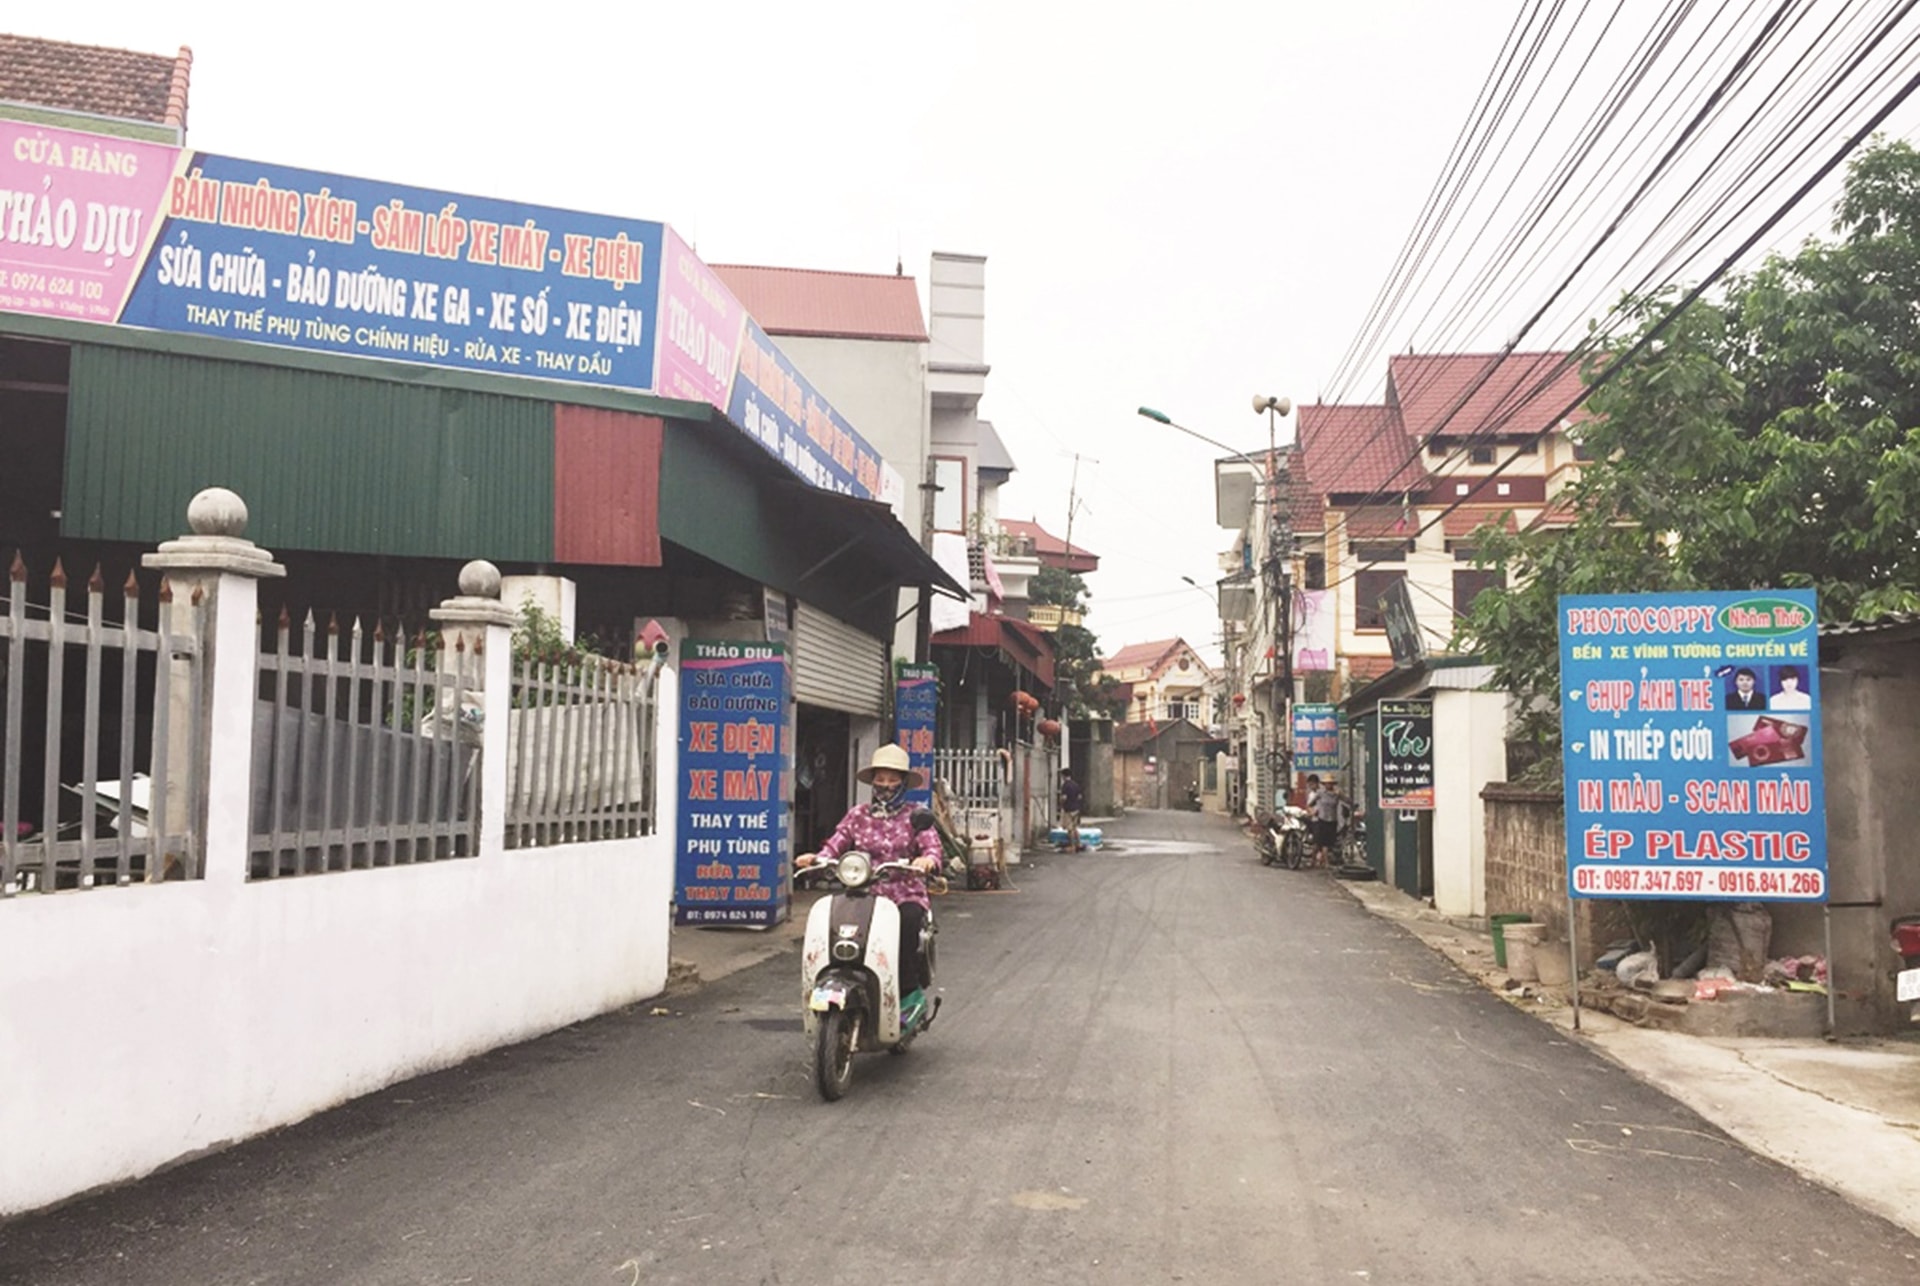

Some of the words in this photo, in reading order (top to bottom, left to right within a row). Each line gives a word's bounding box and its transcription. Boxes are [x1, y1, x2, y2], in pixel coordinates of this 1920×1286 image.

[14, 131, 65, 167] CỬA
[69, 143, 138, 177] HÀNG
[0, 175, 78, 249] THẢO
[82, 202, 142, 268] DỊU
[168, 167, 221, 224] BÁN
[220, 178, 301, 236] NHÔNG
[301, 188, 357, 244] XÍCH
[371, 199, 424, 254] SĂM
[424, 202, 468, 260] LỐP
[467, 219, 499, 266] XE
[500, 219, 549, 272] MÁY
[562, 233, 592, 278] XE
[592, 231, 643, 291] ĐIỆN
[11, 271, 46, 293] 0974
[48, 276, 75, 296] 624
[80, 280, 104, 300] 100
[157, 230, 202, 289] SỬA
[208, 246, 266, 298] CHỮA
[286, 249, 330, 307] BẢO
[334, 265, 407, 317] DƯỠNG
[410, 281, 439, 321] XE
[443, 285, 470, 326] GA
[489, 291, 516, 331] XE
[521, 286, 551, 336] SỐ
[565, 302, 592, 341] XE
[596, 300, 642, 353] ĐIỆN
[186, 304, 231, 328] THAY
[234, 307, 265, 332] THẾ
[267, 316, 301, 340] PHỤ
[305, 316, 350, 343] TÙNG
[355, 325, 409, 351] CHÍNH
[413, 333, 449, 359] HIỆU
[465, 337, 497, 362] RỬA
[500, 346, 521, 364] XE
[535, 351, 575, 372] THAY
[1568, 605, 1717, 635] PHOTOCOPPY
[1728, 607, 1771, 629] Nhâm
[1773, 606, 1806, 629] Thức
[696, 642, 739, 658] THẢO
[1572, 642, 1602, 660] BẾN
[1610, 645, 1630, 659] XE
[1633, 643, 1668, 659] VĨNH
[696, 667, 728, 688] SỬA
[730, 671, 773, 688] CHỮA
[1586, 679, 1634, 718] CHỤP
[1638, 667, 1676, 711] ẢNH
[1680, 667, 1714, 711] THẺ
[688, 690, 720, 712] BẢO
[724, 694, 778, 713] DƯỠNG
[688, 721, 718, 752] XE
[723, 717, 775, 760] ĐIỆN
[1590, 729, 1610, 761] IN
[1615, 719, 1665, 761] THIẾP
[1670, 721, 1714, 761] CƯỚI
[688, 769, 718, 800] XE
[723, 764, 772, 801] MÁY
[1578, 779, 1603, 812] IN
[1609, 773, 1662, 813] MÀU
[1686, 779, 1750, 814] SCAN
[1757, 773, 1812, 814] MÀU
[691, 813, 733, 828] THAY
[738, 809, 769, 829] THẾ
[687, 839, 721, 857] PHỤ
[727, 836, 770, 854] TÙNG
[1584, 825, 1634, 859] ÉP
[1646, 831, 1811, 861] PLASTIC
[736, 865, 761, 879] XE
[1577, 869, 1600, 890] ĐT:
[1604, 870, 1703, 891] 0987.347.697
[1718, 872, 1820, 894] 0916.841.266
[684, 886, 731, 901] THAY
